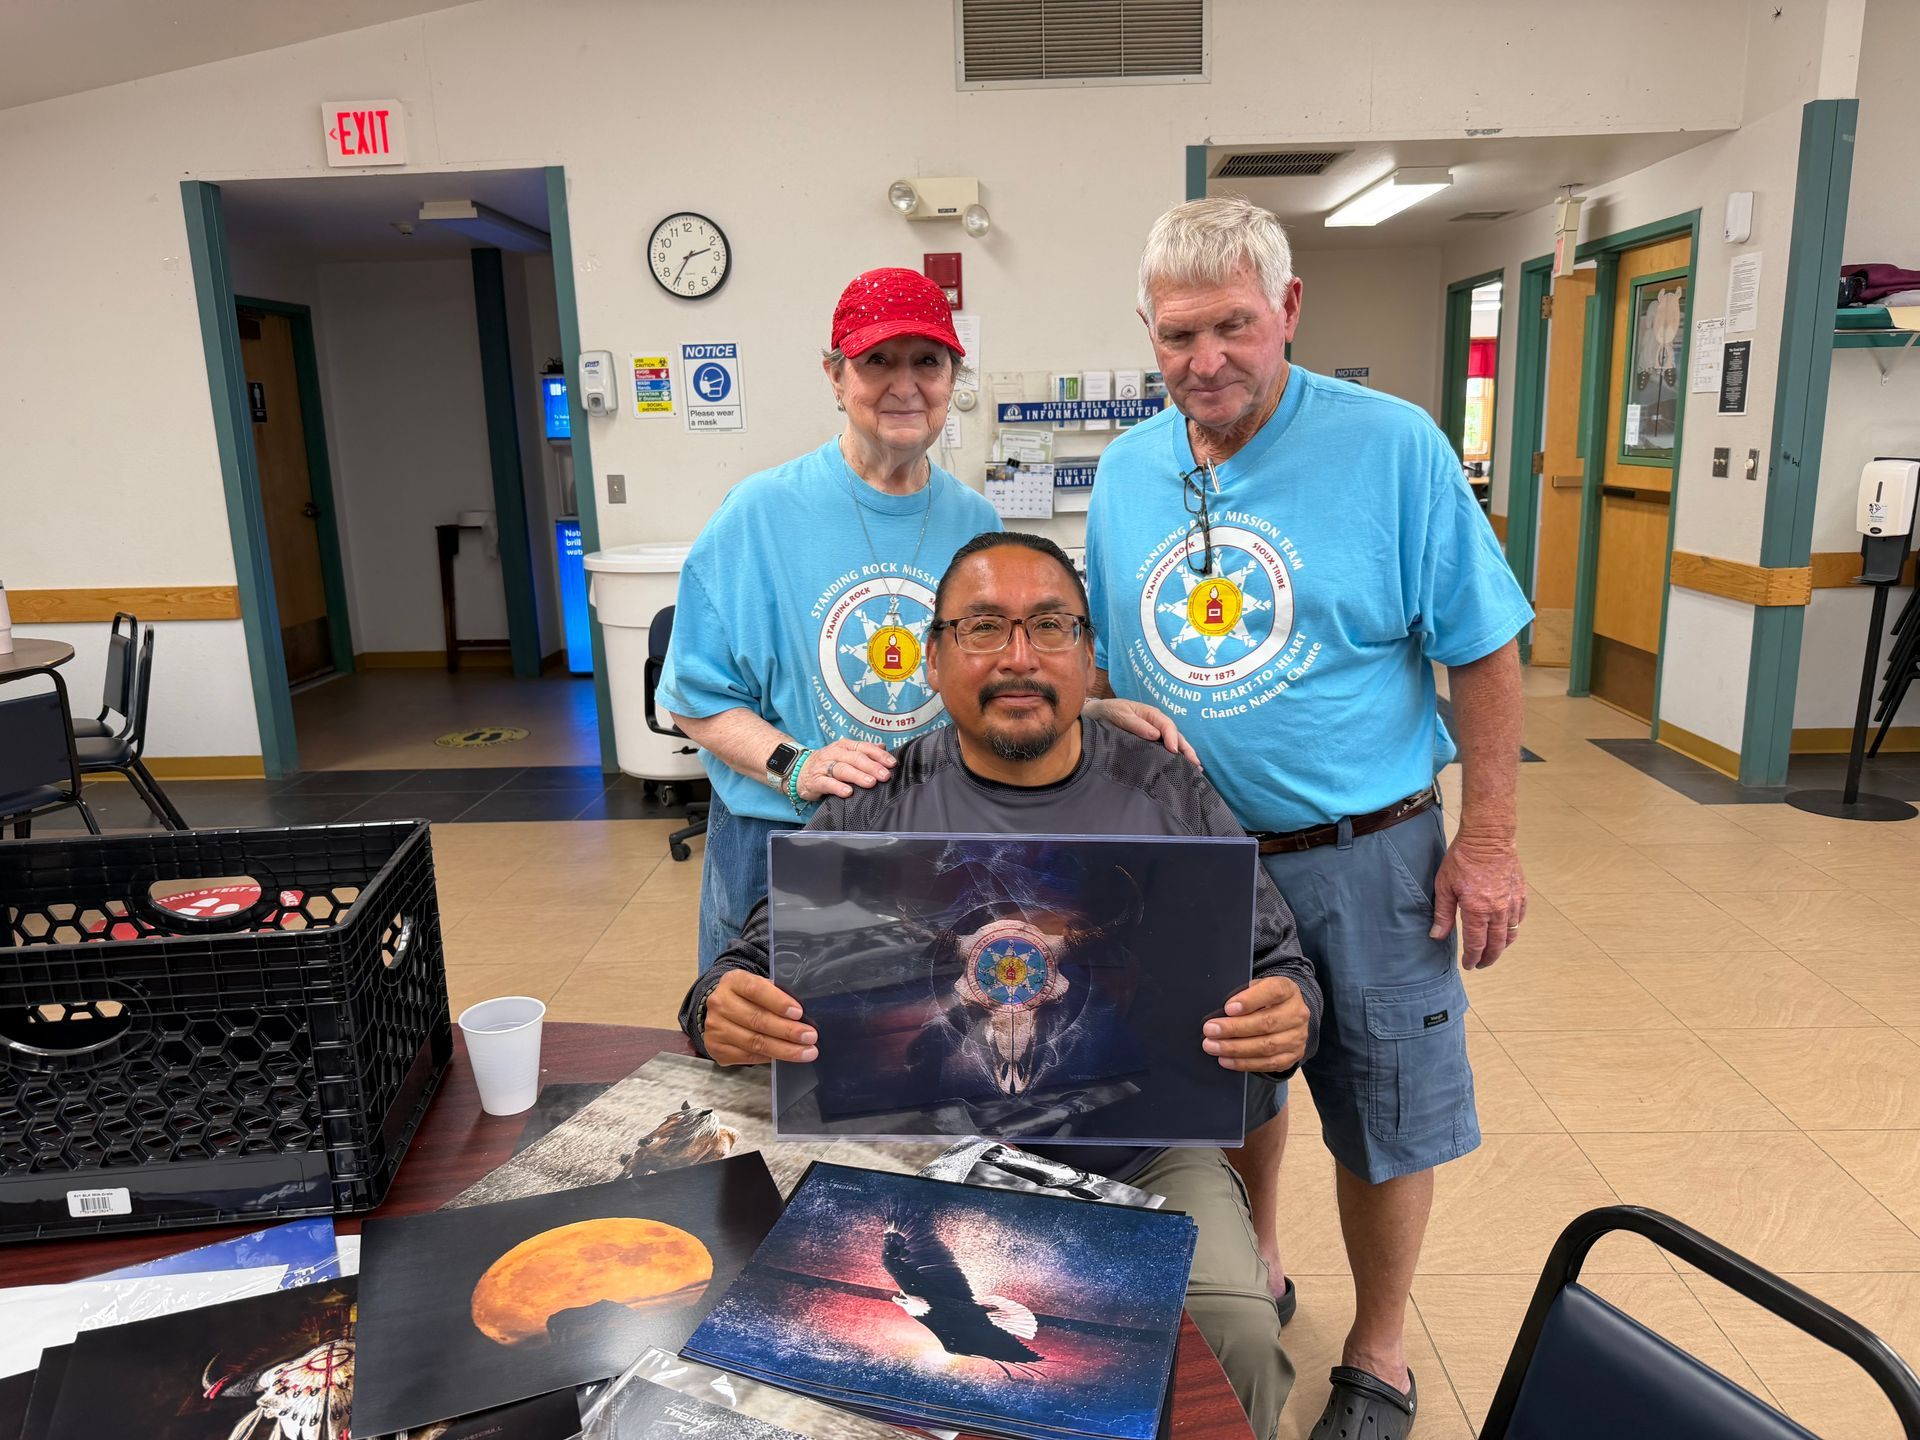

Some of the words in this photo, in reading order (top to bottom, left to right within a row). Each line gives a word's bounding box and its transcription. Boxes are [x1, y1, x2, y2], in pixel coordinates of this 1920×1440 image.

[336, 110, 389, 155] EXIT
[670, 228, 679, 238] 11
[683, 222, 692, 233] 12
[699, 226, 704, 235] 1
[660, 238, 672, 249] 10
[709, 235, 716, 246] 2
[658, 252, 666, 263] 9
[713, 251, 721, 262] 3
[663, 267, 671, 278] 8
[710, 266, 718, 275] 4
[688, 281, 695, 291] 6
[701, 276, 709, 287] 5
[685, 345, 734, 358] NOTICE
[1336, 369, 1368, 377] NOTICE
[1043, 402, 1078, 410] SITTING
[1081, 401, 1102, 409] BULL
[1105, 400, 1143, 408] COLLEGE
[1026, 408, 1108, 420] INFORMATION
[1113, 406, 1159, 417] CENTER
[1054, 469, 1078, 477] TTING
[1135, 525, 1186, 580] STANDING
[1190, 511, 1220, 530] RCK
[1225, 510, 1280, 540] MISSION
[1278, 536, 1304, 571] TEAM
[1252, 542, 1275, 565] SIOUX
[1146, 557, 1174, 599] STANDING
[1272, 564, 1286, 590] TRIBE
[811, 570, 859, 619] STANDING
[862, 562, 898, 576] ROCK
[902, 564, 940, 589] MISSIO
[826, 600, 850, 640] STANDING
[848, 586, 871, 602] ROCK
[1188, 671, 1211, 682] JULY
[1214, 669, 1236, 681] 1873
[1200, 704, 1248, 719] Chante
[1248, 680, 1290, 709] Nakun
[1286, 642, 1322, 681] Chante
[1161, 695, 1188, 716] Nape
[870, 715, 893, 727] JULY
[895, 716, 916, 727] 1873
[156, 892, 195, 905] TAIN
[211, 885, 249, 895] FEET
